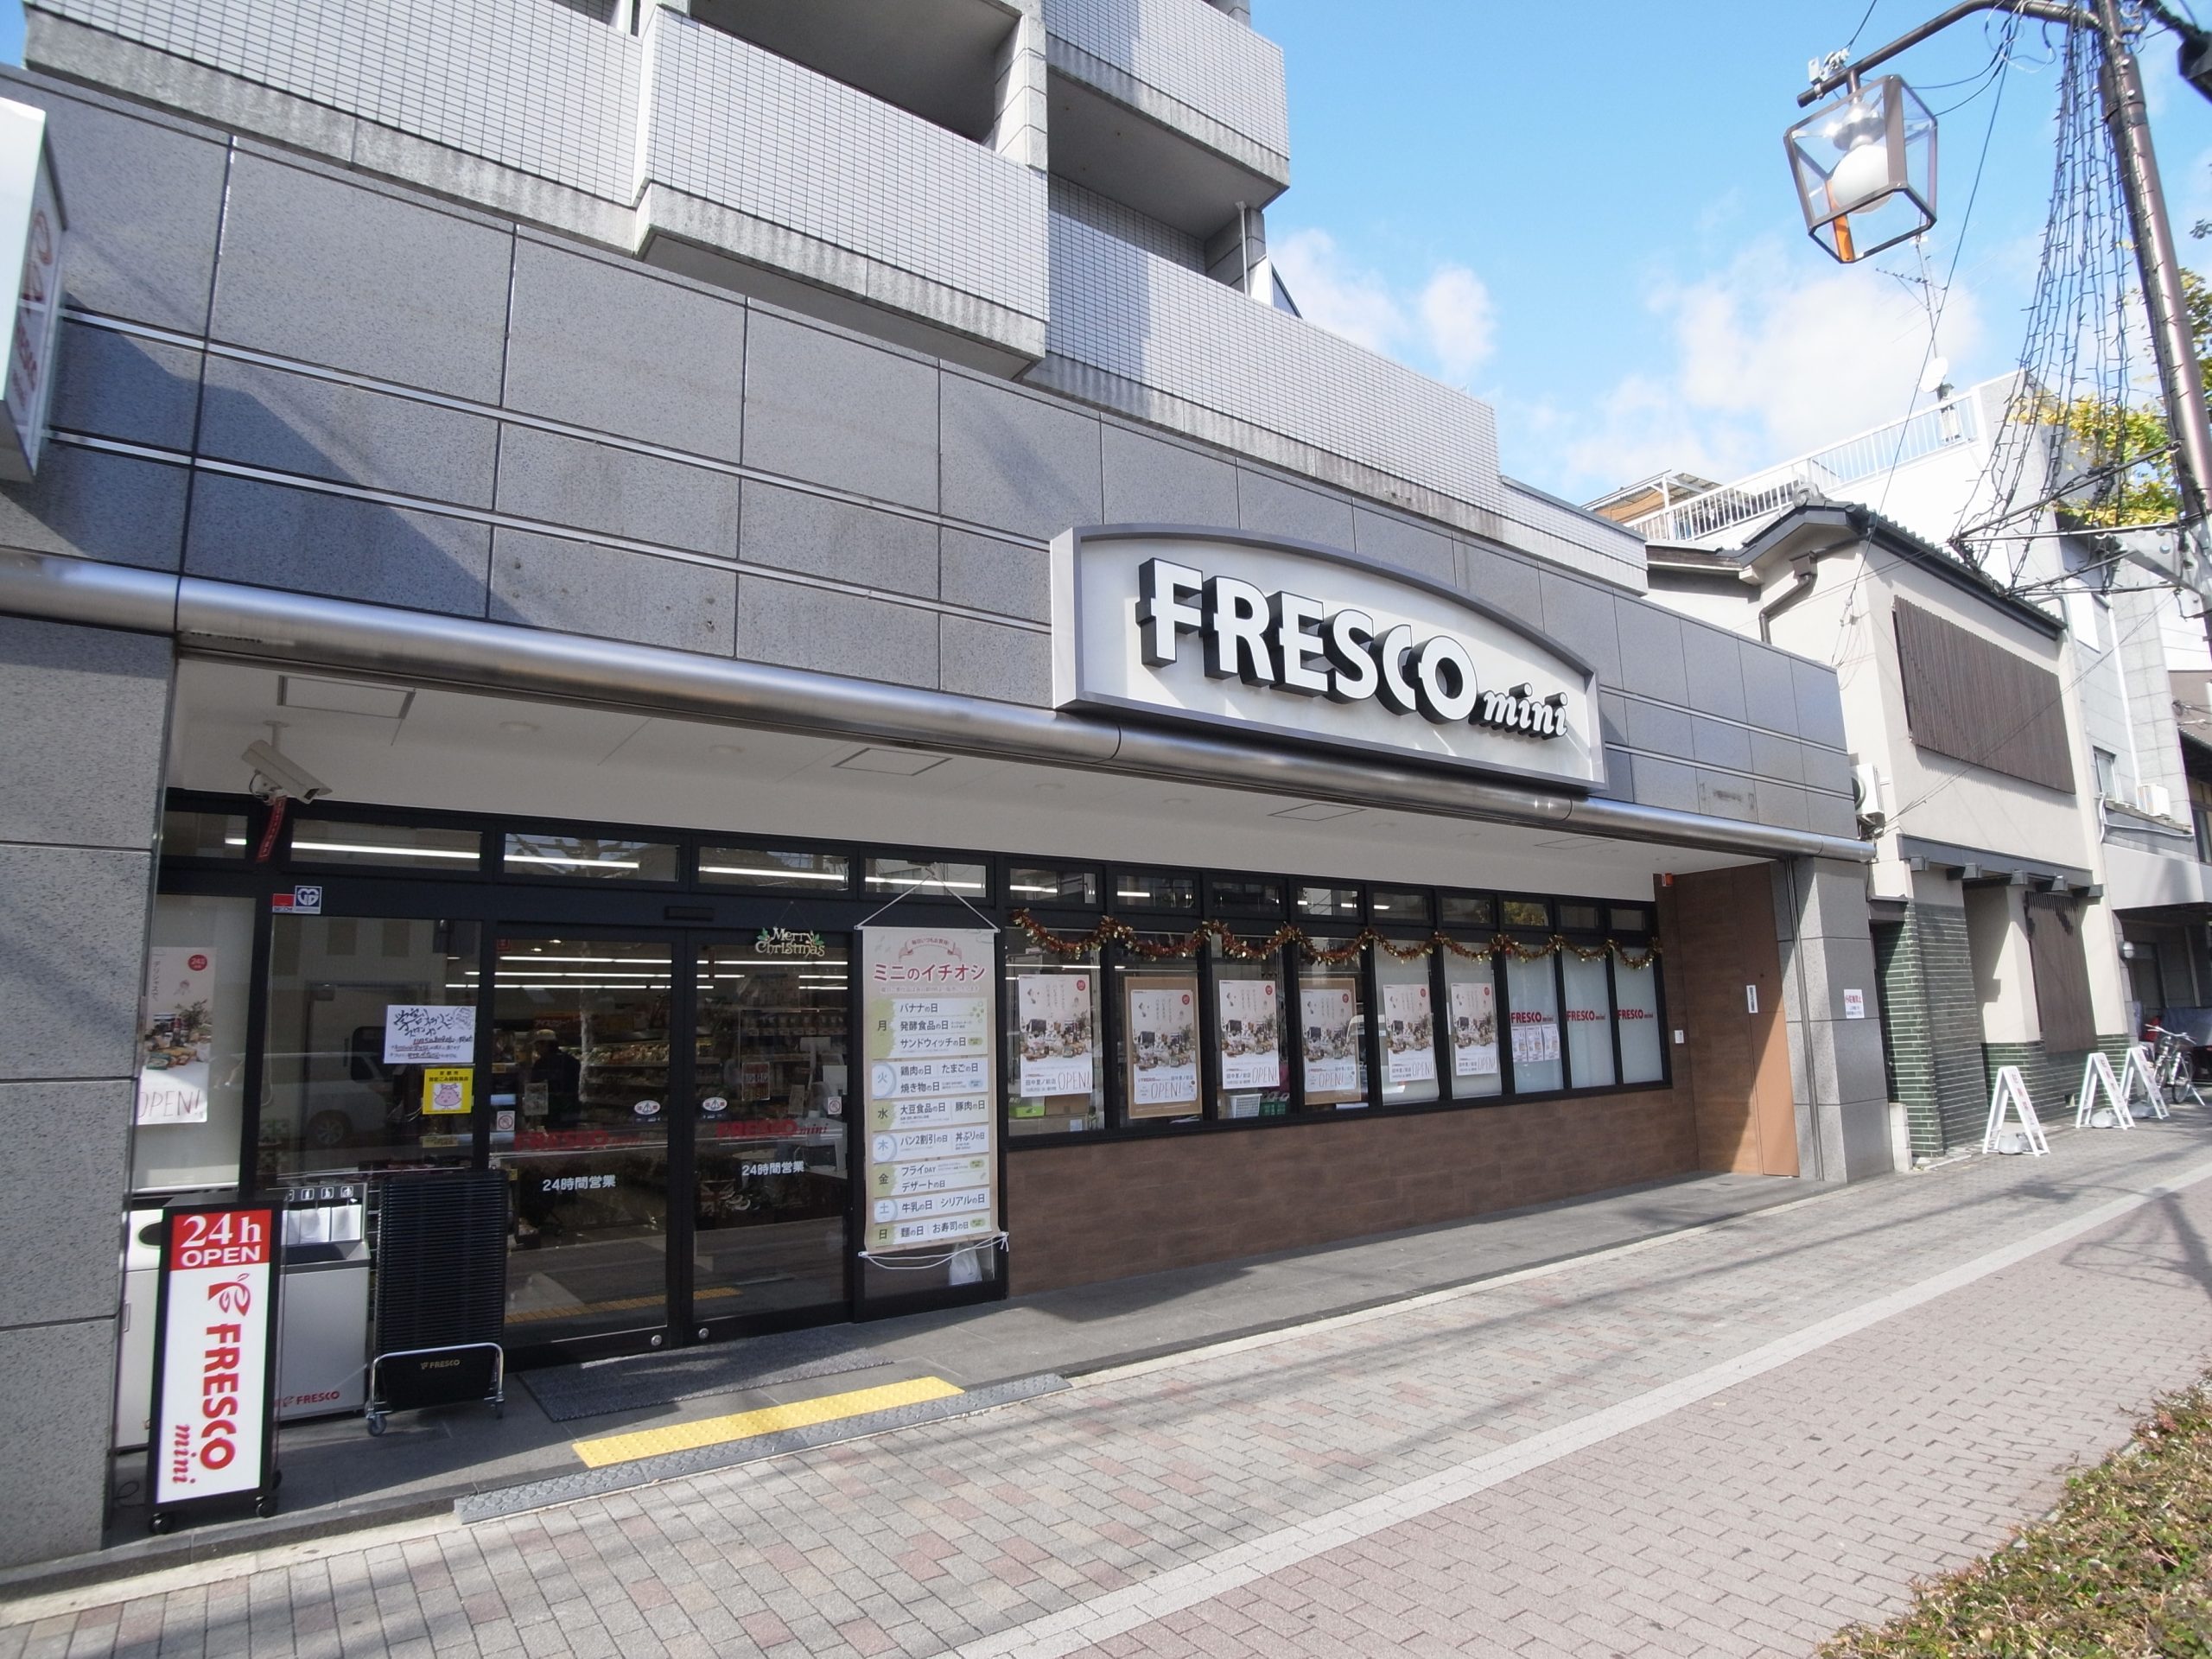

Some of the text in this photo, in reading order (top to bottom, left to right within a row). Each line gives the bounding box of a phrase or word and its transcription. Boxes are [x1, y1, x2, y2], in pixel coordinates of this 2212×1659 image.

[1136, 557, 1569, 740] FRESCO mini
[772, 926, 814, 945] Merry
[755, 942, 825, 958] Christmas
[874, 963, 985, 982] ミニのイチオシ
[899, 1003, 938, 1014] バナナの日
[1566, 1010, 1595, 1021] FRESCO
[1617, 1009, 1644, 1020] FRESCO
[1511, 1012, 1541, 1023] FRESCO
[877, 1020, 887, 1032] 月
[899, 1020, 949, 1031] 発酵食品の日
[899, 1037, 966, 1049] サンドウィッチの日
[900, 1062, 978, 1076] 鶏肉の日 たまごの日
[877, 1072, 888, 1084] 火
[1058, 1071, 1091, 1091] OPEN!
[900, 1082, 940, 1093] 焼き物の日
[1150, 1080, 1182, 1100] OPEN!
[877, 1108, 888, 1120] 水
[899, 1100, 985, 1115] 大豆食品の日 豚肉の日
[878, 1140, 889, 1152] 木
[899, 1134, 948, 1147] パン2割引の日
[955, 1132, 985, 1142] 丼ぶりの日
[741, 1160, 804, 1176] 24時間営業
[542, 1174, 616, 1192] 24時間営業
[878, 1173, 889, 1185] 金
[901, 1179, 945, 1193] デザートの日
[879, 1203, 889, 1214] 土
[901, 1193, 985, 1213] 牛乳の日 シリアルの日
[878, 1228, 888, 1240] 日
[932, 1220, 969, 1234] お寿司の日
[181, 1245, 260, 1268] OPEN
[429, 1359, 461, 1369] FRESCO
[200, 1323, 242, 1471] FRESCO
[296, 1390, 340, 1406] FRESCO
[172, 1423, 198, 1484] mini
